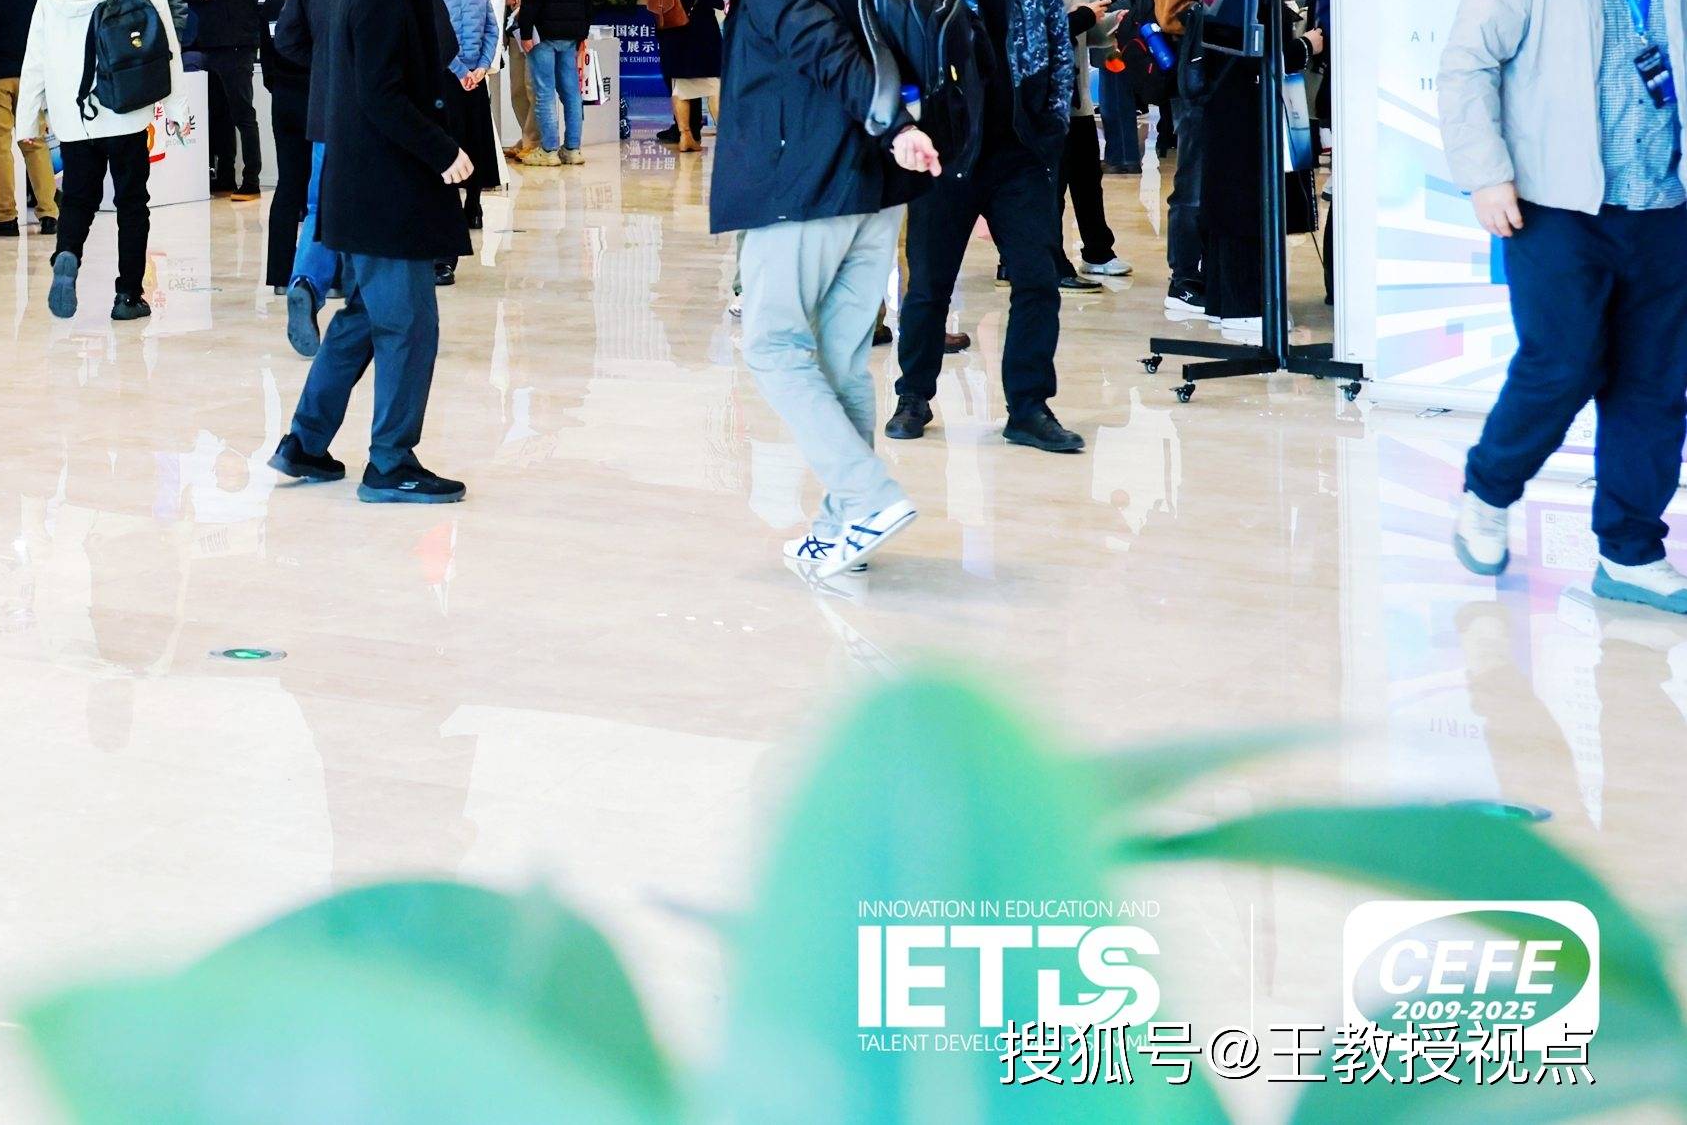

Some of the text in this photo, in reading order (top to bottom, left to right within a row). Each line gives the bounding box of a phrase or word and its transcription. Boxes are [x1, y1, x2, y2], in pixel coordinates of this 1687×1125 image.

[612, 24, 656, 38] 国家自
[620, 41, 660, 53] 展示
